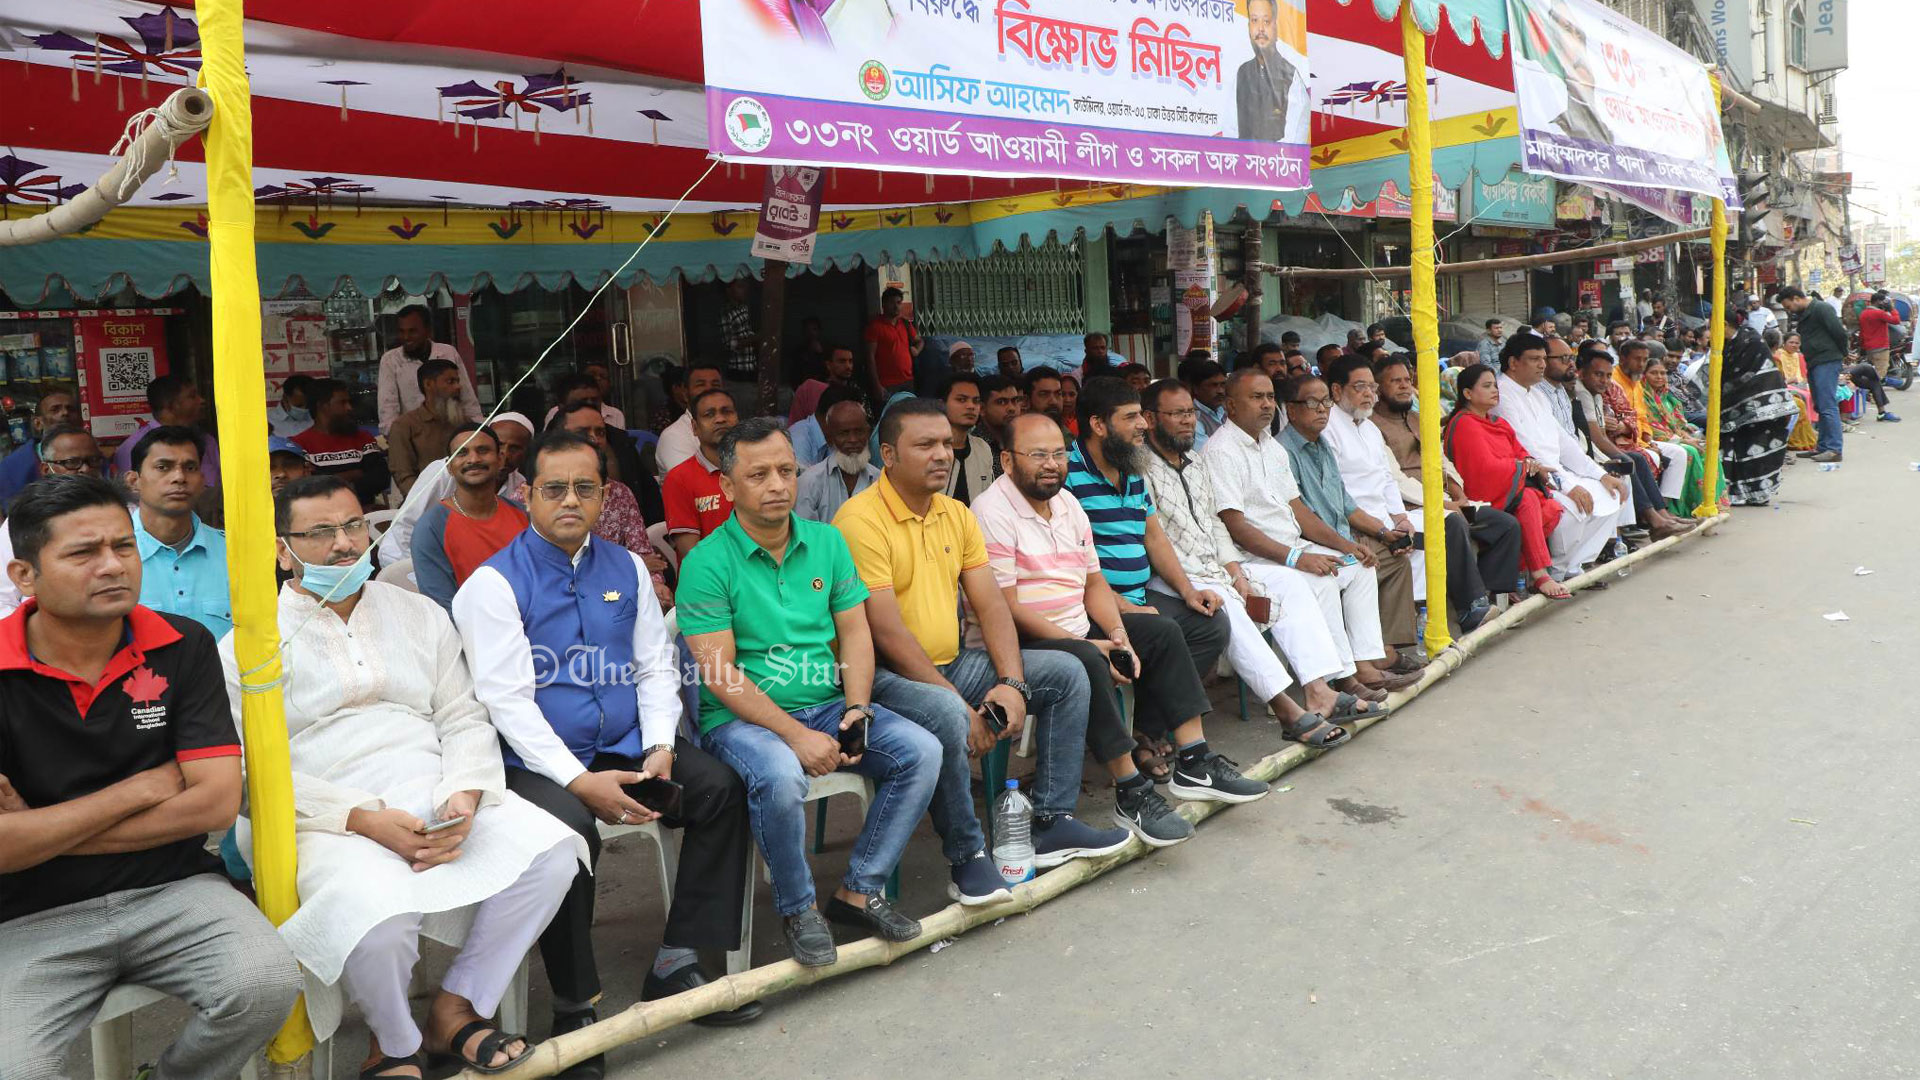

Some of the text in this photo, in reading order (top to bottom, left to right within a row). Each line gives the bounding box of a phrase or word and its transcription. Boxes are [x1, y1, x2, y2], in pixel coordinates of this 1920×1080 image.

[994, 0, 1222, 89] বিক্ষোভ মিছিল
[1715, 29, 1728, 70] eans
[892, 64, 981, 104] আসিফ
[985, 80, 1071, 115] আহমেদ
[785, 119, 1303, 180] ৩৩নং ওয়ার্ড আওয়ামী লীগ ও সকল অঙ্গ সংগঠন
[103, 321, 146, 336] বিকাশ
[112, 336, 140, 347] করুন
[314, 450, 361, 463] FASHION
[131, 705, 166, 715] Canadian
[1001, 865, 1024, 875] Fresh
